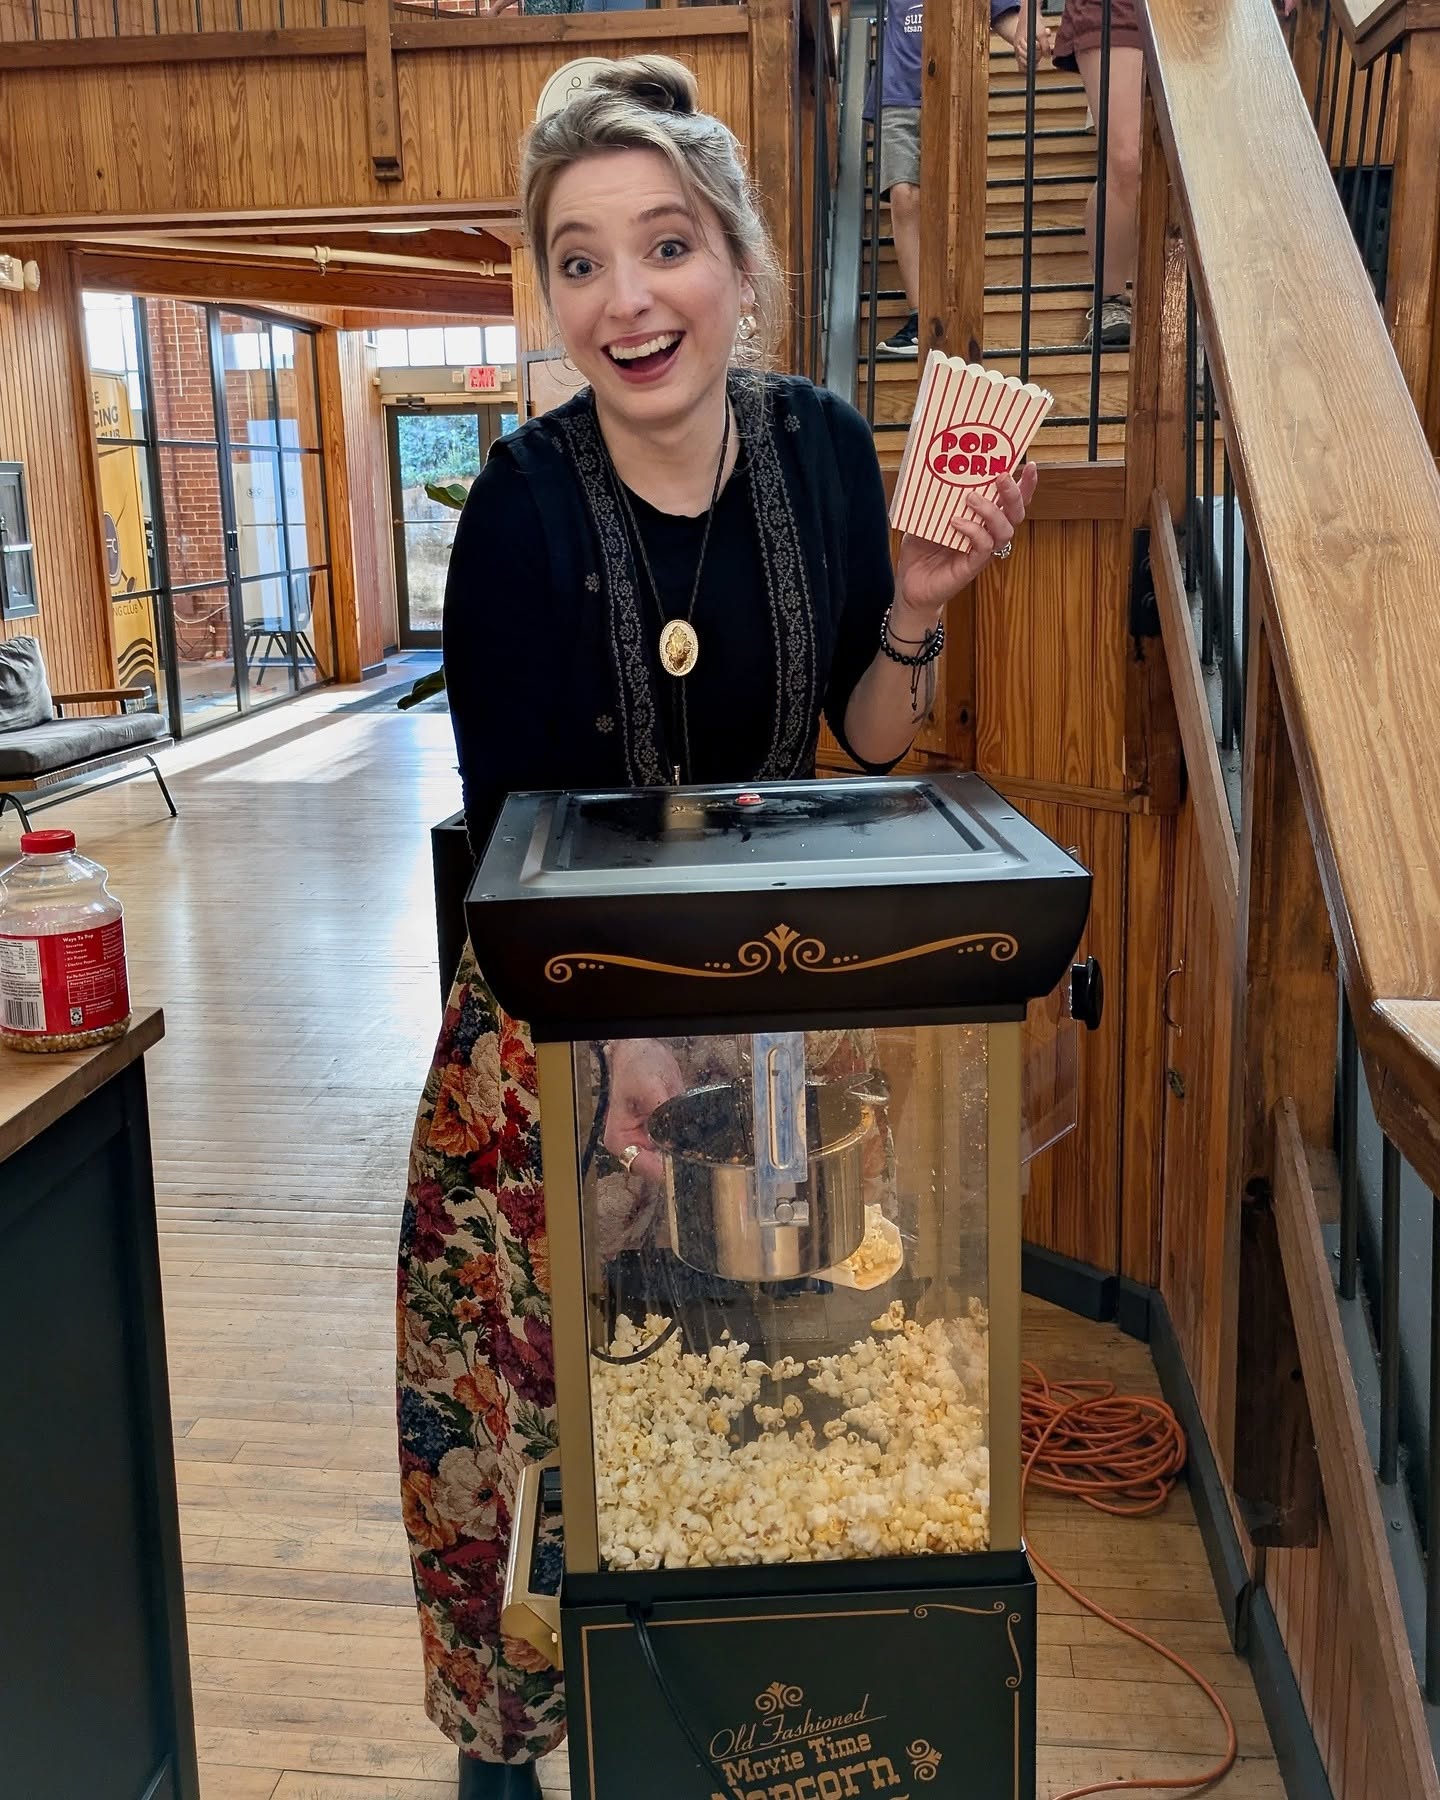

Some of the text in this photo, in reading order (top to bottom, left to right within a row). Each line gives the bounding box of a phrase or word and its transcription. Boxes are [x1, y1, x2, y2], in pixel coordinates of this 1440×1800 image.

[941, 432, 998, 454] POP
[933, 454, 1007, 477] CORN
[709, 1693, 870, 1760] Old Fashioned
[711, 1756, 902, 1800] pcorn
[721, 1733, 873, 1787] Movie Time
